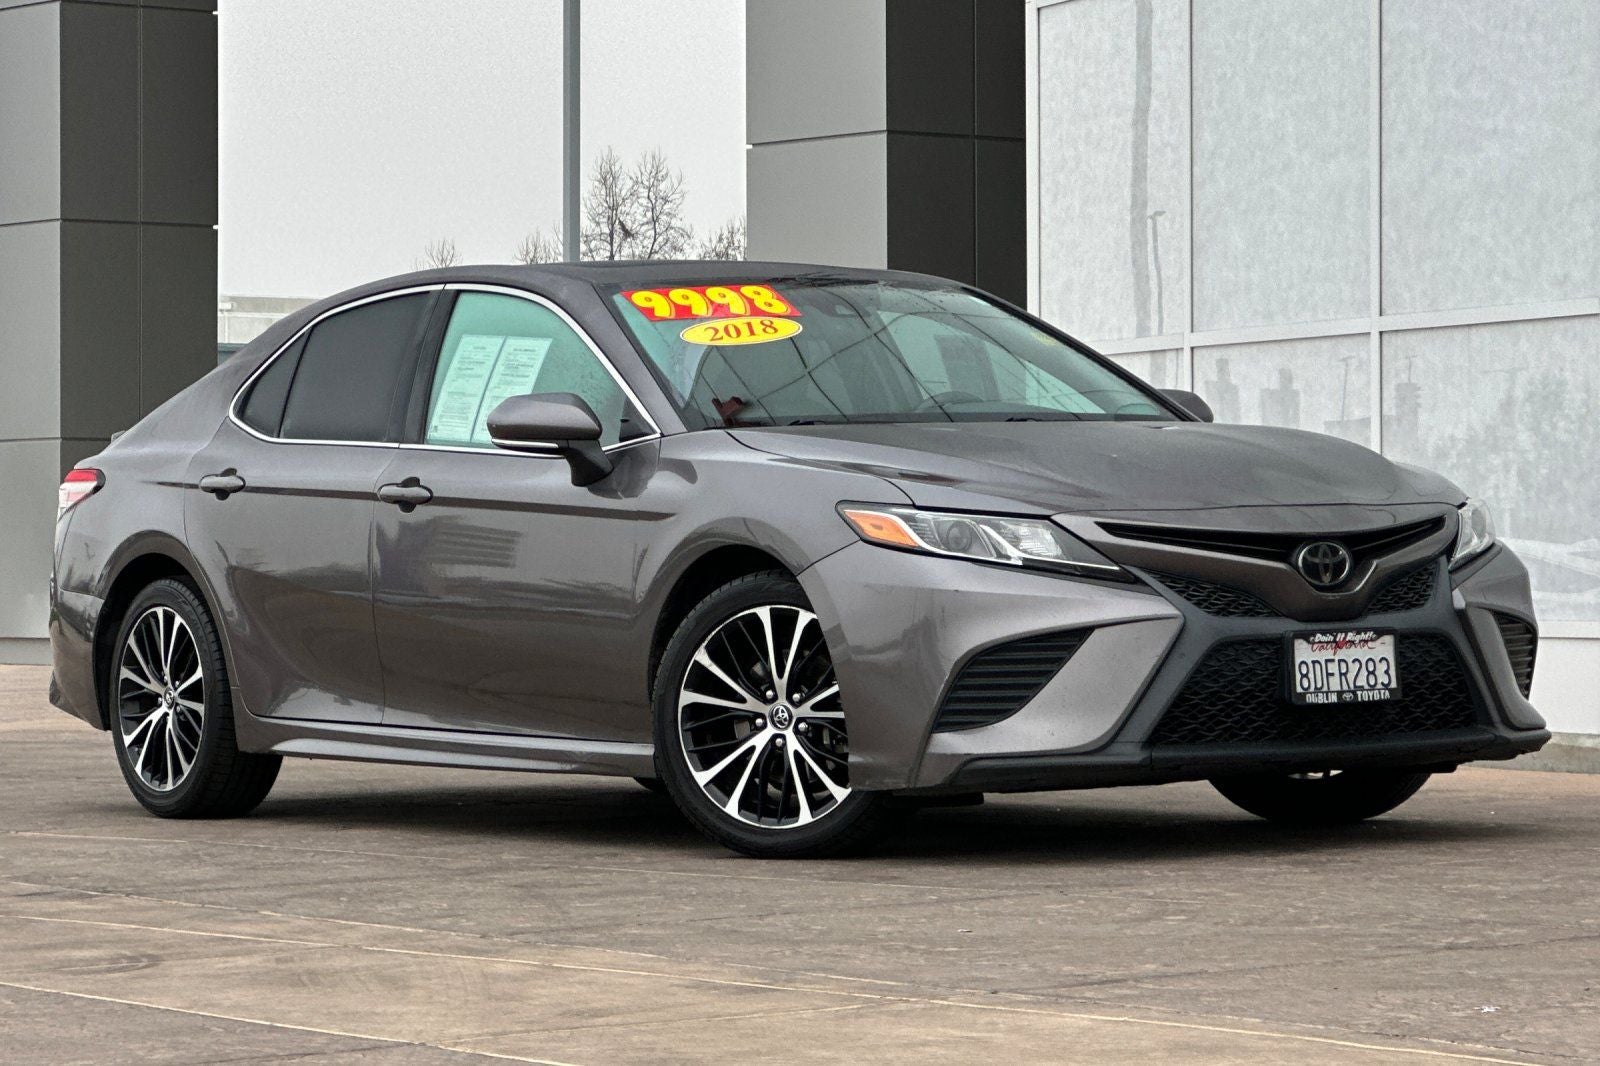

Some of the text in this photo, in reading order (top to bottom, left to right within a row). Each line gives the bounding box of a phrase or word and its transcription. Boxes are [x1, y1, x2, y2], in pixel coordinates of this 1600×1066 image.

[631, 285, 791, 318] 9998
[704, 319, 778, 342] 2018
[1298, 656, 1392, 691] 8DFR283
[1305, 690, 1391, 704] DUBLIN TOYOTA
